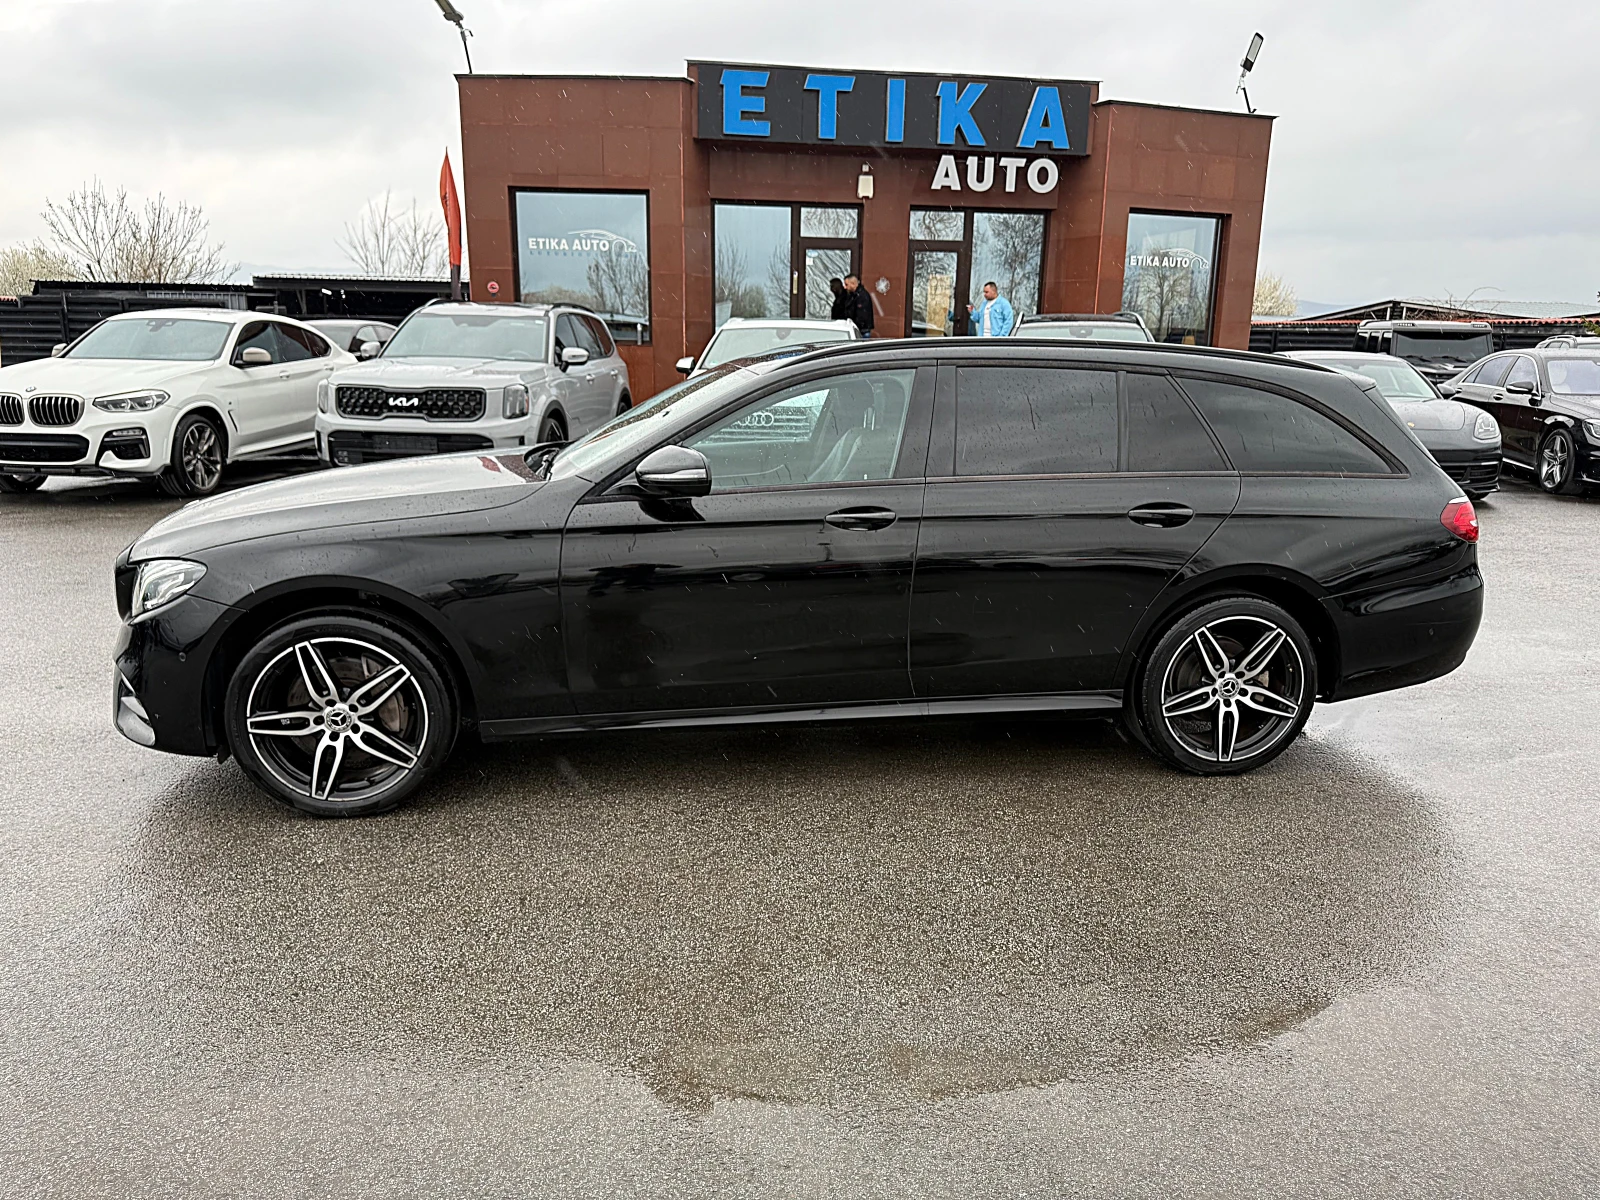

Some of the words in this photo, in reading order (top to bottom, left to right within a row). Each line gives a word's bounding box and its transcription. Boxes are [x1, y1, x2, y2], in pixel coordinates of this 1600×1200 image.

[720, 69, 1070, 149] ETIKA
[931, 155, 1059, 193] AUTO
[528, 238, 569, 250] ETIKA
[572, 239, 609, 251] AUTO
[1130, 255, 1159, 267] ETIKA
[1161, 257, 1190, 268] AUTO
